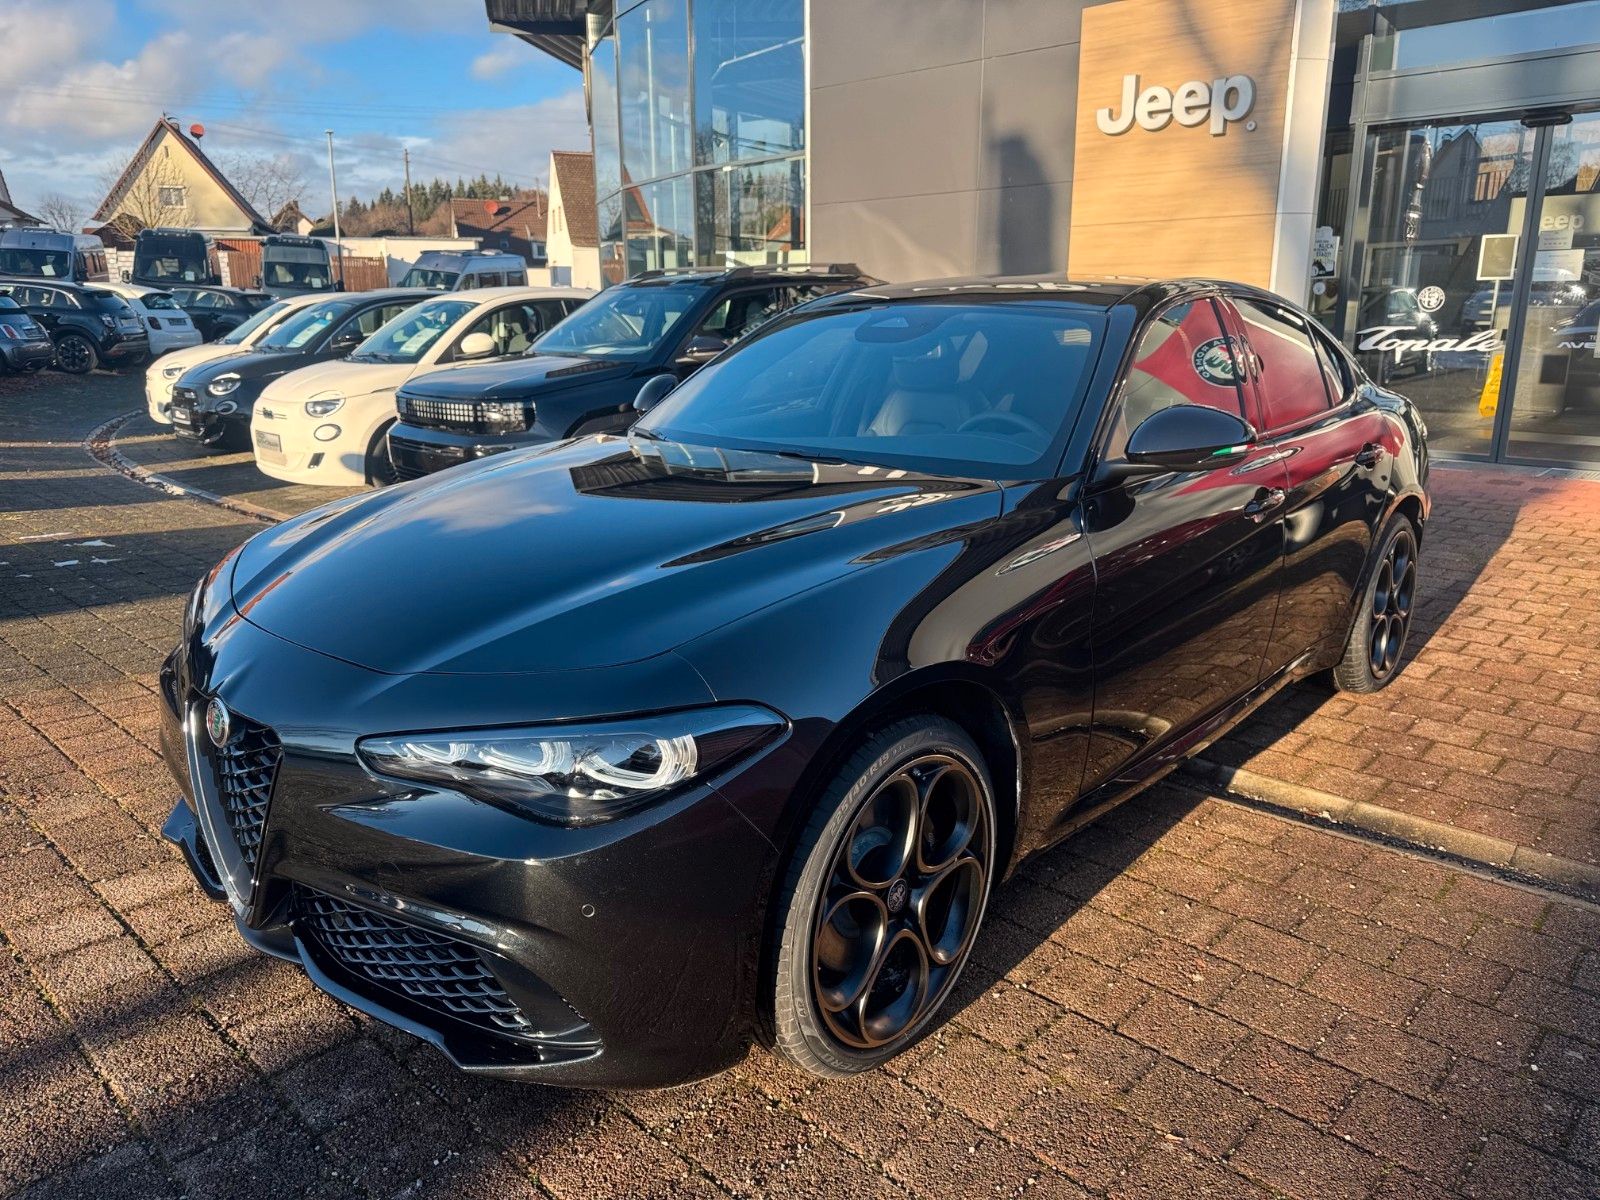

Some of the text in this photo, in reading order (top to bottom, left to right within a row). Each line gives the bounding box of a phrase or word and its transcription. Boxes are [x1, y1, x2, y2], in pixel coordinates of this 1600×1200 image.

[1096, 74, 1257, 137] Jeep
[1541, 214, 1584, 233] eep
[1356, 326, 1506, 364] Tonale
